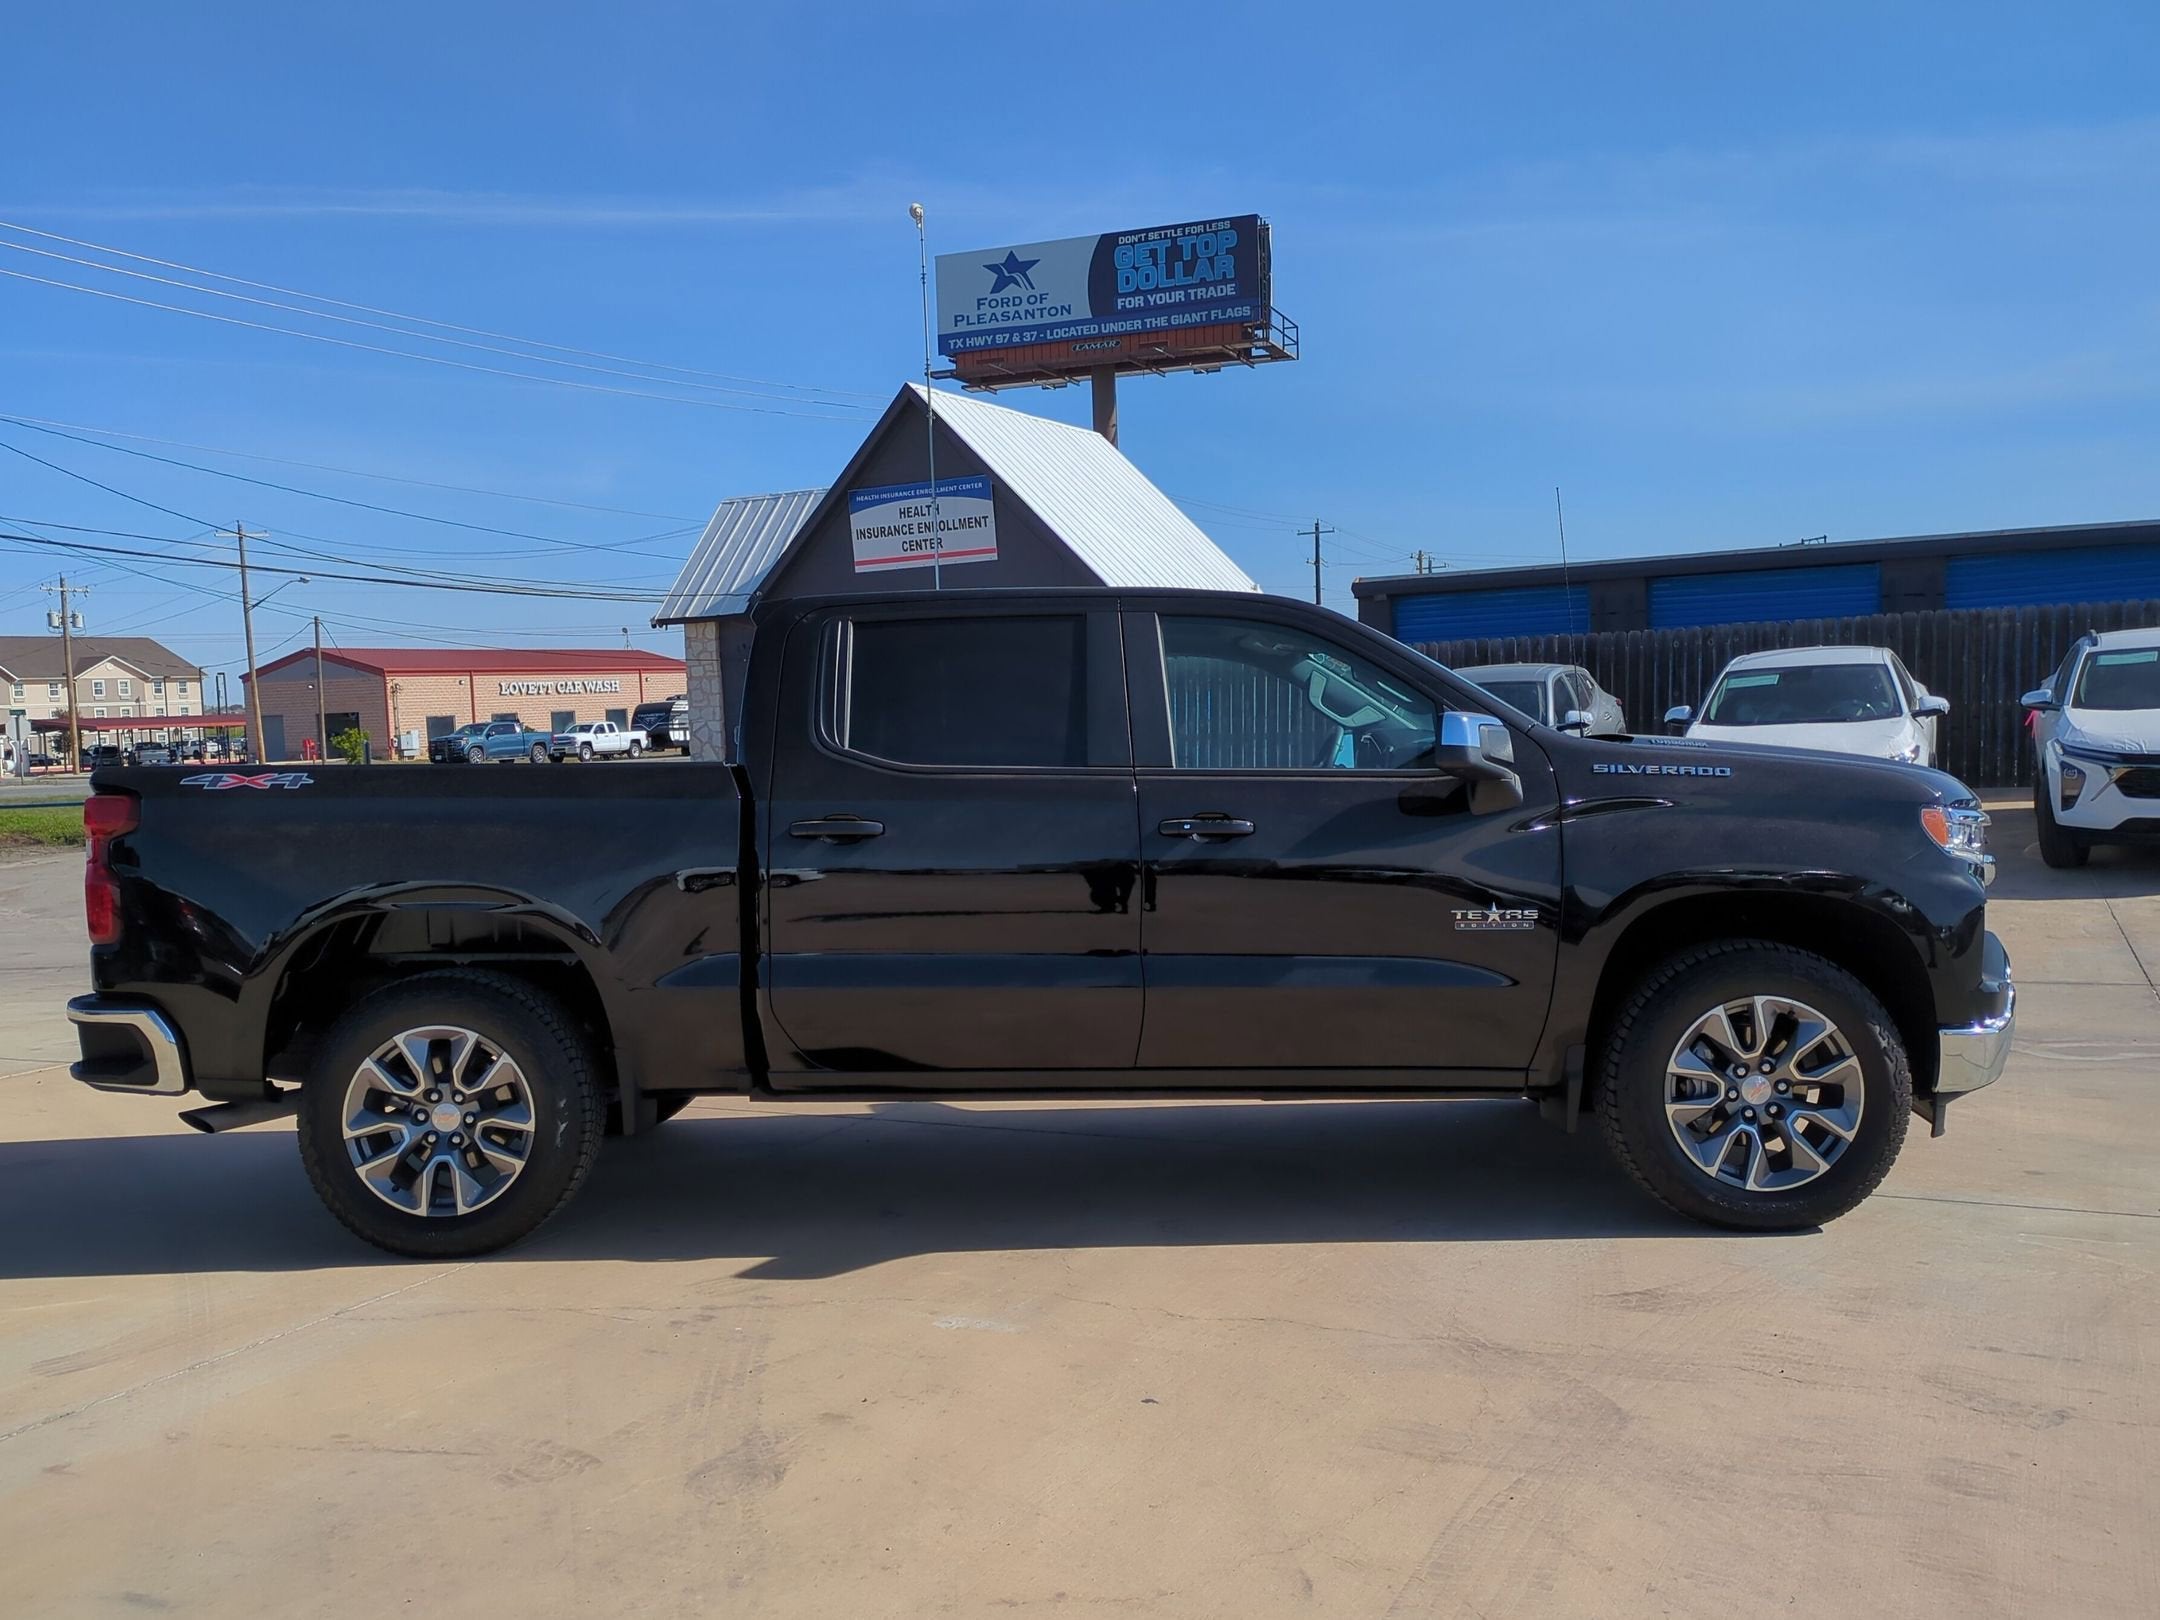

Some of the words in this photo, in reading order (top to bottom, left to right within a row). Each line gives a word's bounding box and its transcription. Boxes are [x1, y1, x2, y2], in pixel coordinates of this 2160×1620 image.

[1118, 233, 1147, 245] DON'T
[1148, 227, 1184, 241] SETTLE
[1185, 224, 1205, 236] FOR
[1206, 220, 1231, 232] LESS
[1114, 239, 1171, 269] GET
[1177, 229, 1238, 260] TOP
[1117, 254, 1235, 293] DOLLAR
[976, 295, 1023, 311] FORD
[1026, 292, 1049, 305] OF
[1117, 295, 1144, 310] FOR
[1146, 290, 1186, 305] YOUR
[1188, 283, 1237, 300] TRADE
[953, 304, 1072, 328] PLEASANTON
[948, 338, 964, 350] TX
[966, 334, 994, 348] HWY
[995, 332, 1010, 344] 97
[1012, 332, 1021, 343] &
[1023, 331, 1038, 342] 37
[1046, 324, 1099, 340] LOCATED
[1101, 319, 1142, 334] UNDER
[1144, 315, 1169, 329] THE
[1171, 310, 1209, 326] GIANT
[1210, 305, 1251, 321] FLAGS
[1074, 340, 1117, 352] LAMAR
[856, 494, 880, 502] HEALTH
[880, 489, 915, 500] INSURANCE
[958, 482, 983, 491] CENTER
[856, 523, 914, 541] INSURANCE
[902, 537, 943, 552] CENTER
[499, 681, 554, 696] LOVETT
[556, 680, 582, 694] CAR
[582, 680, 620, 693] WASH
[1592, 764, 1733, 776] SILVERADO
